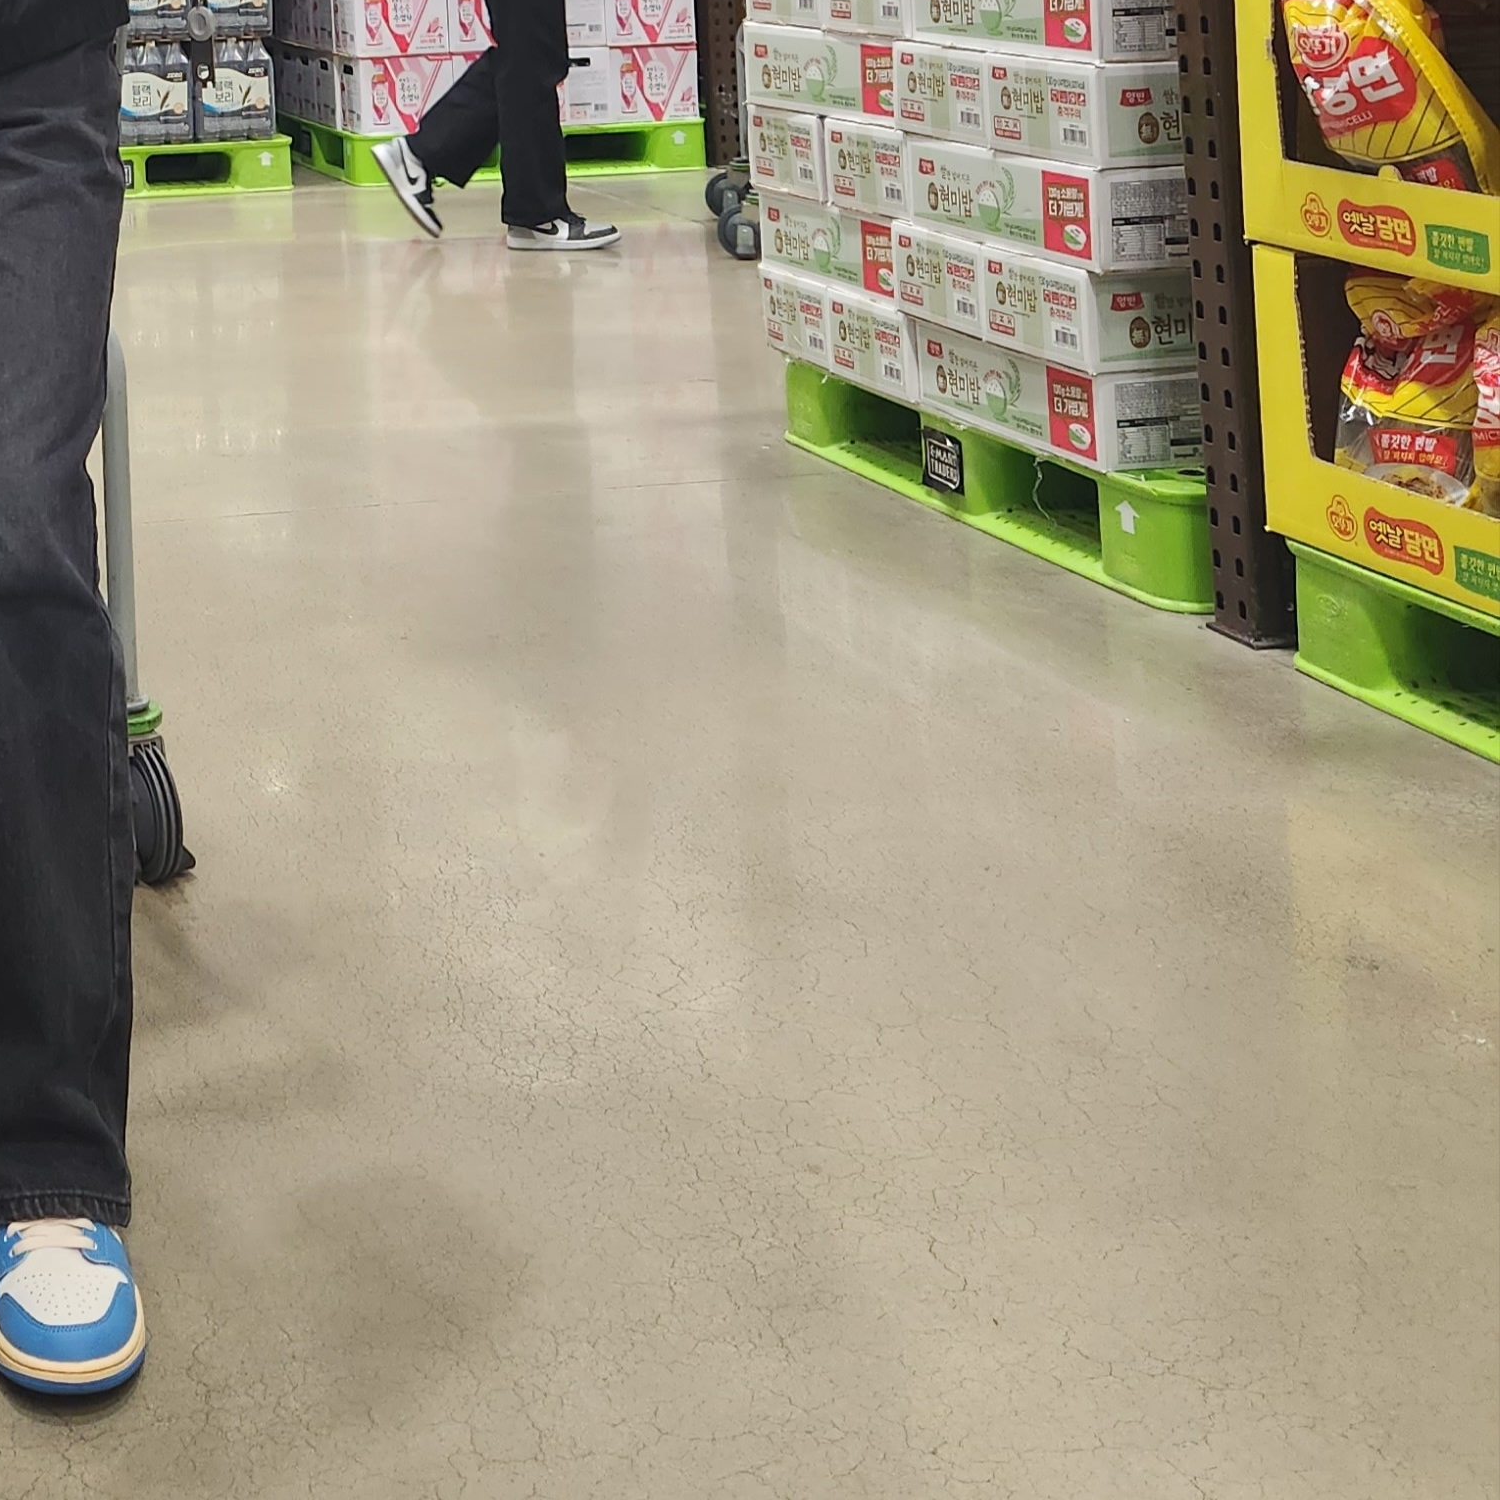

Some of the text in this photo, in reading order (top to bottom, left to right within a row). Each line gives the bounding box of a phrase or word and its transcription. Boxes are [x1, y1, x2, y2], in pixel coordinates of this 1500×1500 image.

[1011, 85, 1045, 114] 현미밥
[938, 184, 973, 218] 현미밥
[1342, 211, 1413, 245] 옛날 당면
[1007, 282, 1038, 313] 현미밥
[947, 368, 981, 403] 현미밥
[1369, 519, 1440, 565] 옛날 당면
